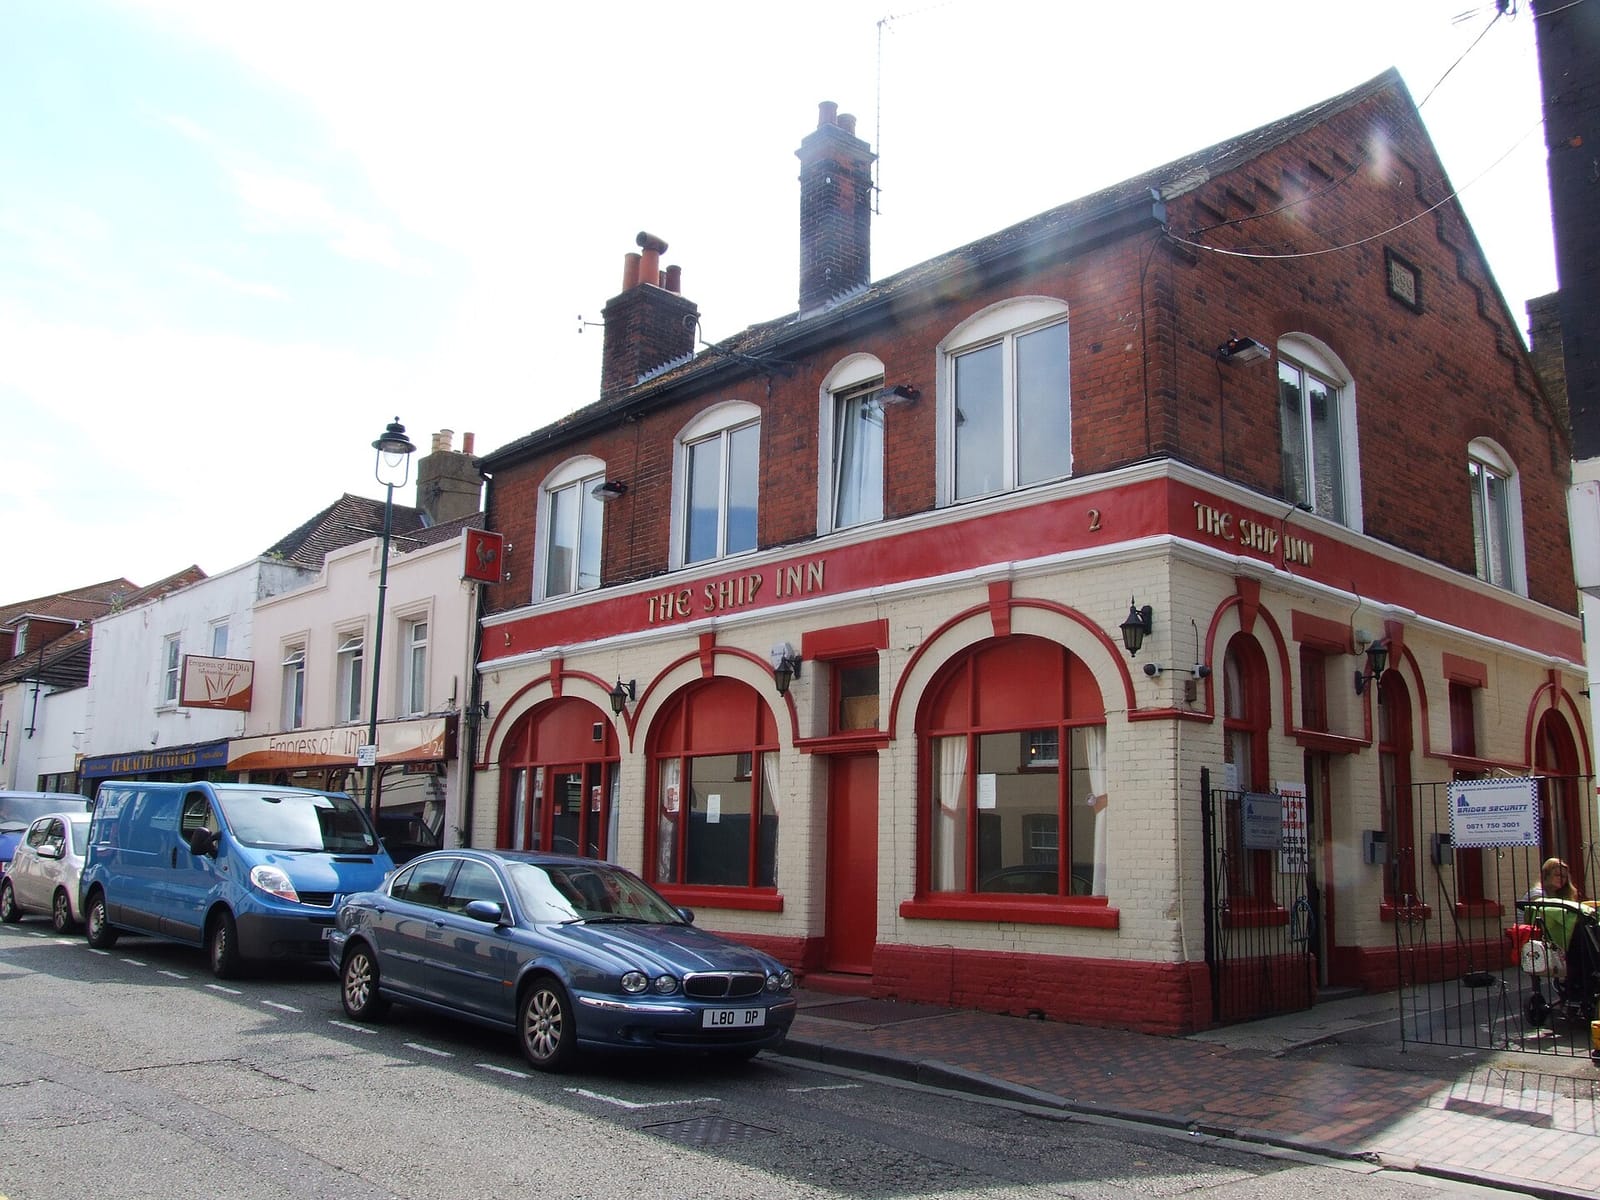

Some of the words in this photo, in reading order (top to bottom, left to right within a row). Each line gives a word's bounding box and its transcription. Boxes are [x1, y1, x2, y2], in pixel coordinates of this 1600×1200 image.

[1087, 508, 1102, 533] 2
[1193, 500, 1235, 541] THE
[1239, 519, 1280, 555] SHIP
[1284, 534, 1314, 568] INN
[646, 588, 694, 624] THE
[703, 574, 763, 612] SHIP
[776, 559, 826, 599] INN
[503, 631, 512, 648] 2
[268, 737, 318, 761] Empress
[320, 730, 335, 756] of
[432, 740, 444, 757] 24
[1457, 806, 1486, 814] BRIDGE
[1488, 804, 1528, 812] SECURITY
[711, 1010, 735, 1026] L80
[744, 1010, 759, 1025] DP
